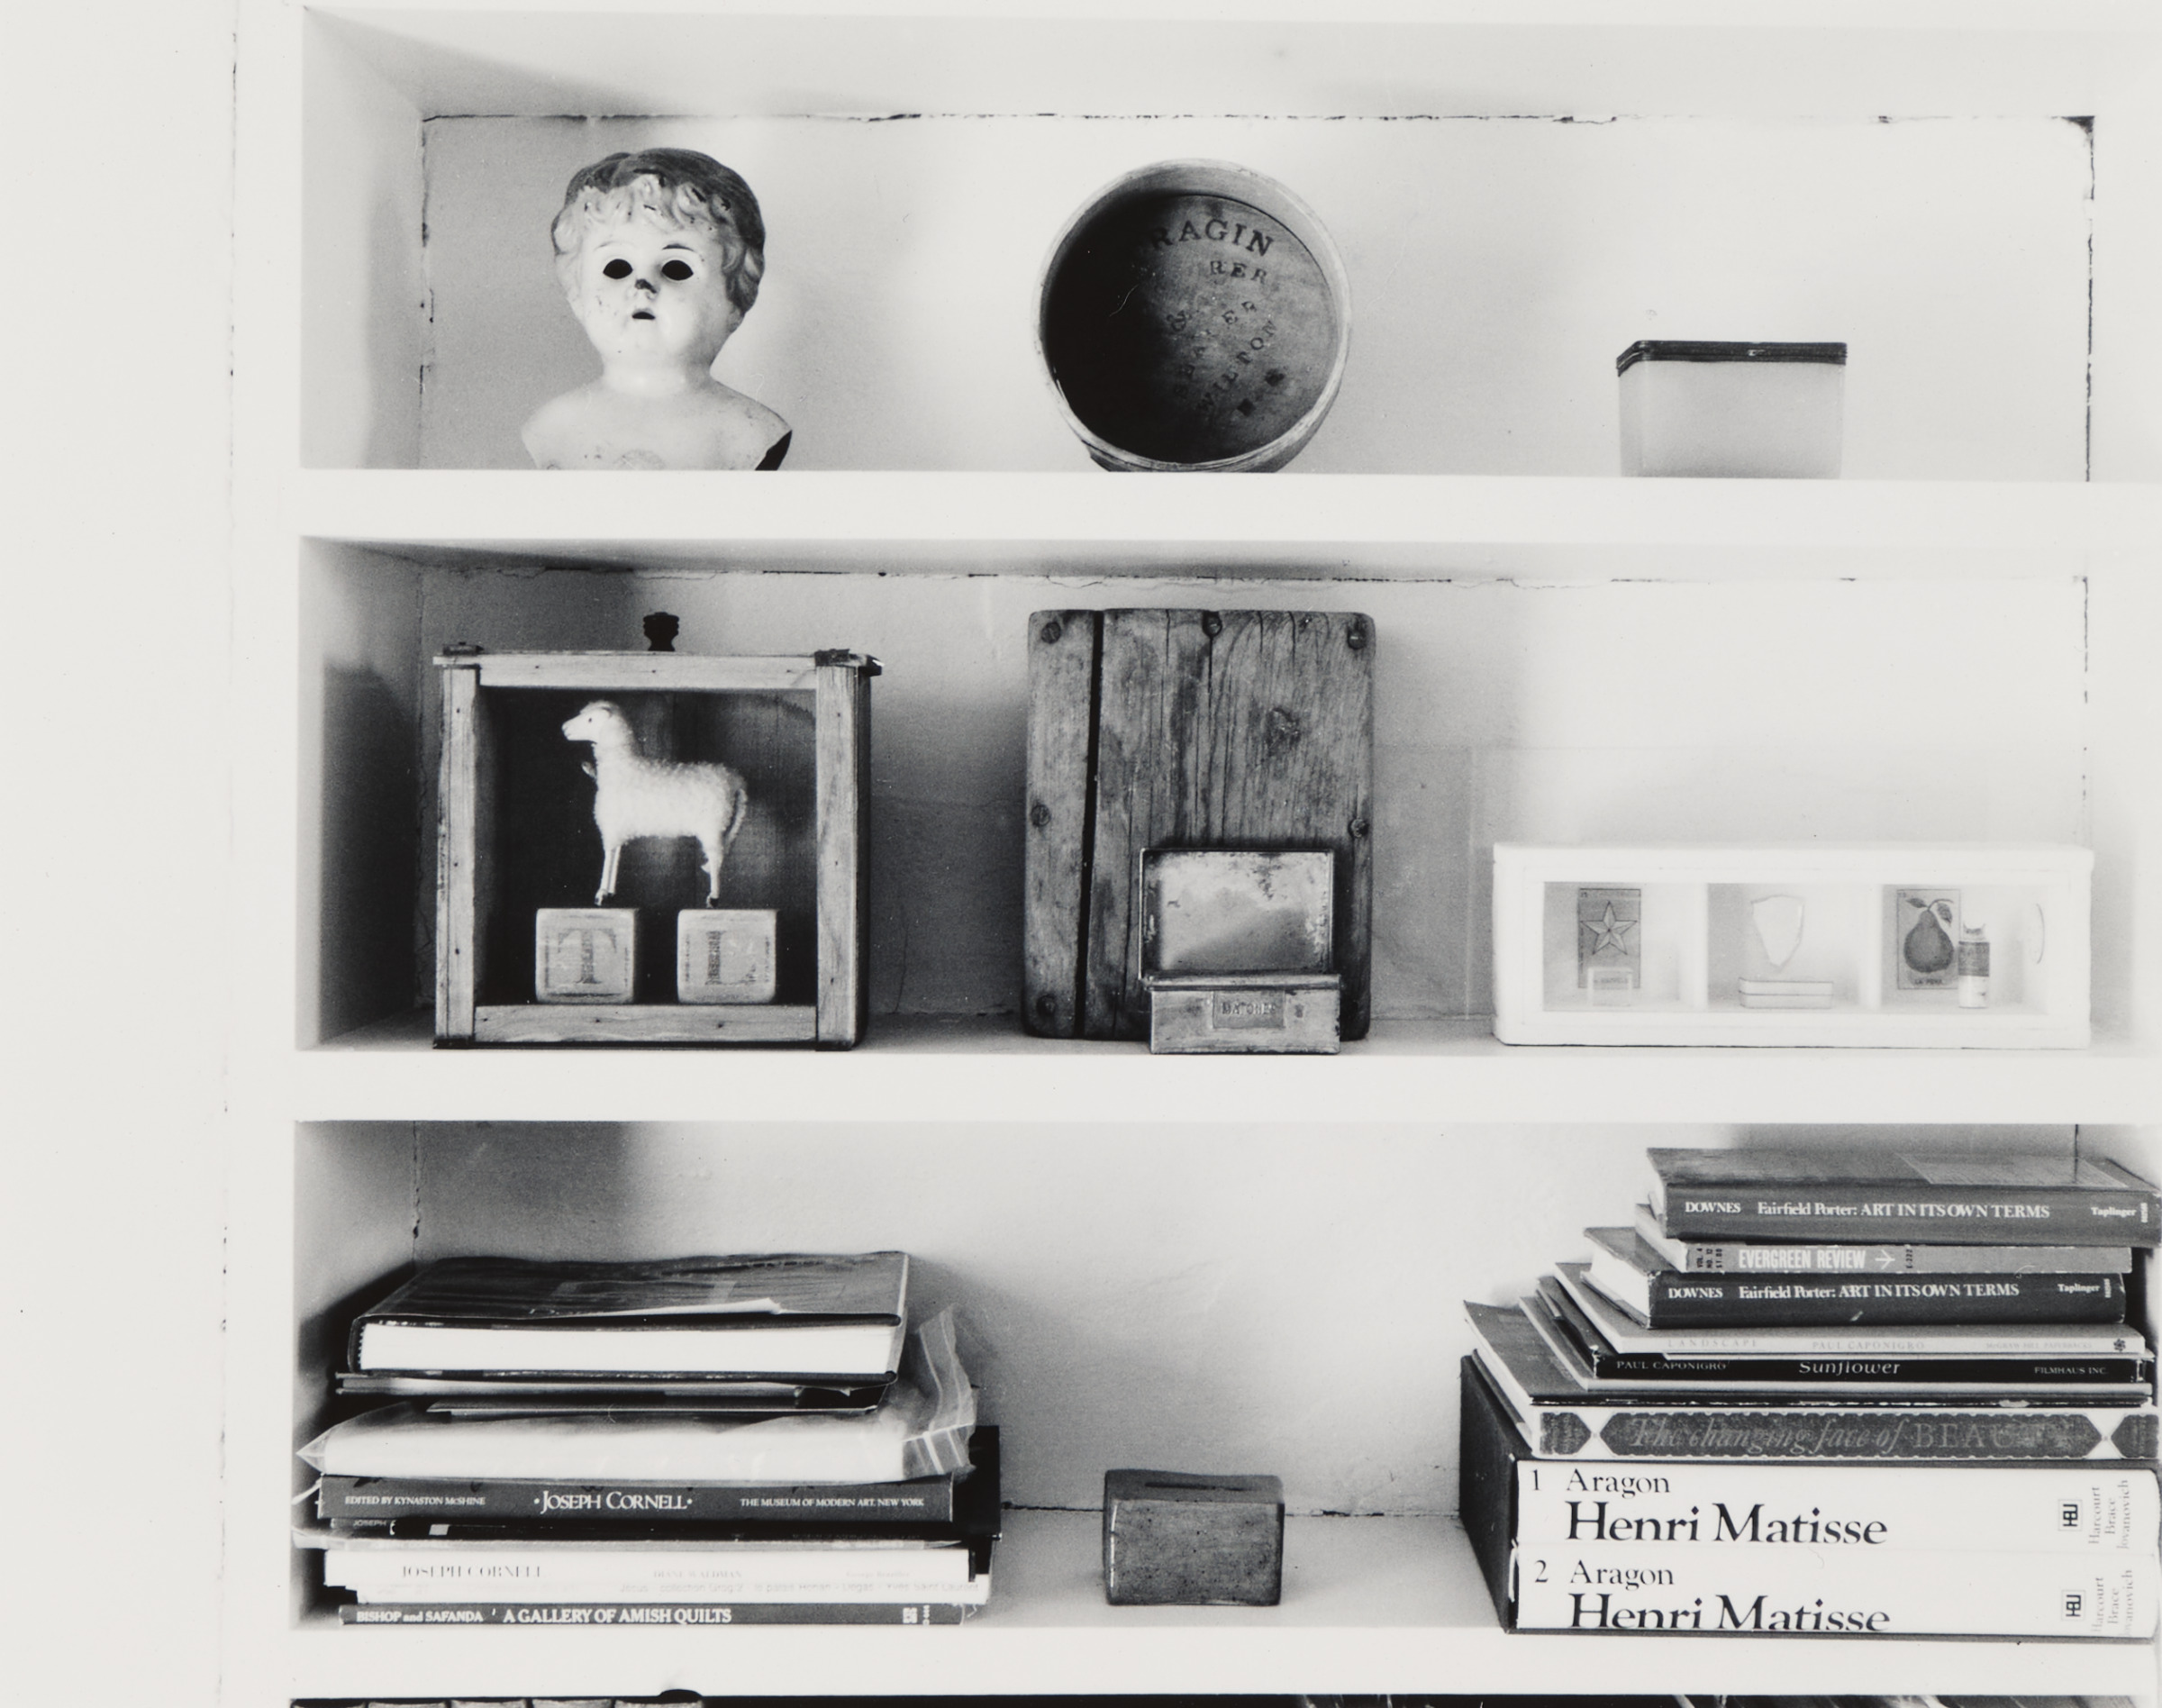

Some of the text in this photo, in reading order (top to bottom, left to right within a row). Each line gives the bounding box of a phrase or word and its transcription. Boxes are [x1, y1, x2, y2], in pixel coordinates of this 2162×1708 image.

[557, 927, 618, 985] T
[704, 930, 758, 986] L
[1685, 1201, 2051, 1219] DOWNES Fairfield Porter: ART IN ITS OWN TERMS
[2090, 1206, 2137, 1220] Taplinger
[1739, 1248, 1867, 1269] EVERGREEN REVIEW
[1668, 1283, 2020, 1299] DOWNES Fairfield Porter: ART IN ITS OWN TERMS
[2057, 1283, 2101, 1295] Taplinger
[1667, 1338, 1758, 1349] LANDSCAPE
[1812, 1340, 1926, 1351] PAUL CAPONIGRO
[1616, 1360, 1727, 1371] PAUL CAPONIGRO
[1798, 1360, 1901, 1376] Sunflower
[2033, 1367, 2085, 1376] FILMHAUS
[1630, 1417, 1685, 1447] The
[1688, 1417, 1805, 1455] changing
[1807, 1417, 1871, 1455] face
[1875, 1417, 1912, 1455] of
[1531, 1467, 1671, 1499] 1 Aragon
[344, 1495, 486, 1506] EDITED BY KYNASTON McSHINE
[740, 1497, 760, 1507] THE
[761, 1497, 801, 1507] MUSEUM
[802, 1497, 815, 1507] OF
[815, 1497, 856, 1507] MODERN
[877, 1497, 900, 1507] NEW
[900, 1497, 925, 1507] YORK
[1564, 1500, 1888, 1544] Henri Matisse
[2088, 1486, 2102, 1544] Harcourt
[2103, 1497, 2116, 1535] Brace
[402, 1565, 546, 1578] JOSEPH CORNELL
[1533, 1558, 1676, 1591] 2 Aragon
[356, 1611, 484, 1622] BISHOP and SAFANDA
[502, 1608, 732, 1625] A GALLERY OF AMISH QUILTS
[1567, 1592, 1891, 1631] Henri Matisse
